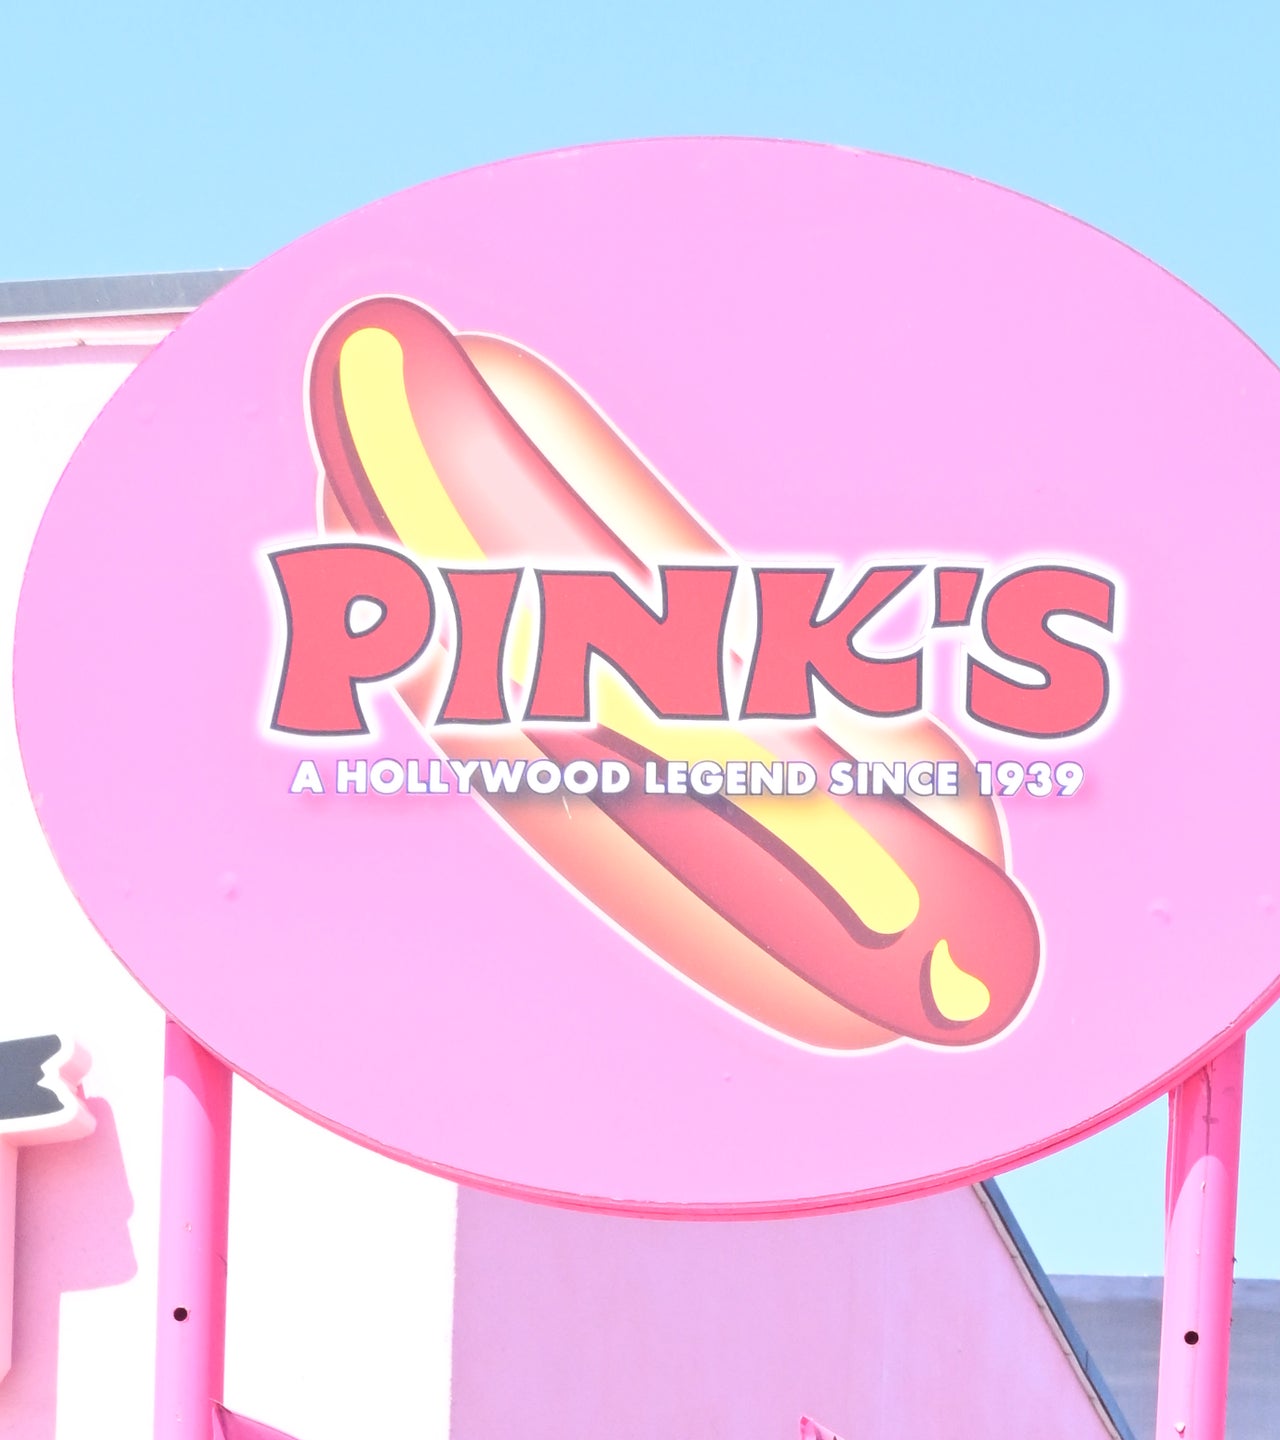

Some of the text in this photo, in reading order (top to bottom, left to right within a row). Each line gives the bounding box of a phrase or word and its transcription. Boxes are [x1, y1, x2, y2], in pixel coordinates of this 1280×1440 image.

[265, 541, 1117, 741] PINK'S
[289, 758, 1085, 798] A HOLLYWOOD LEGEND SINCE 1939
